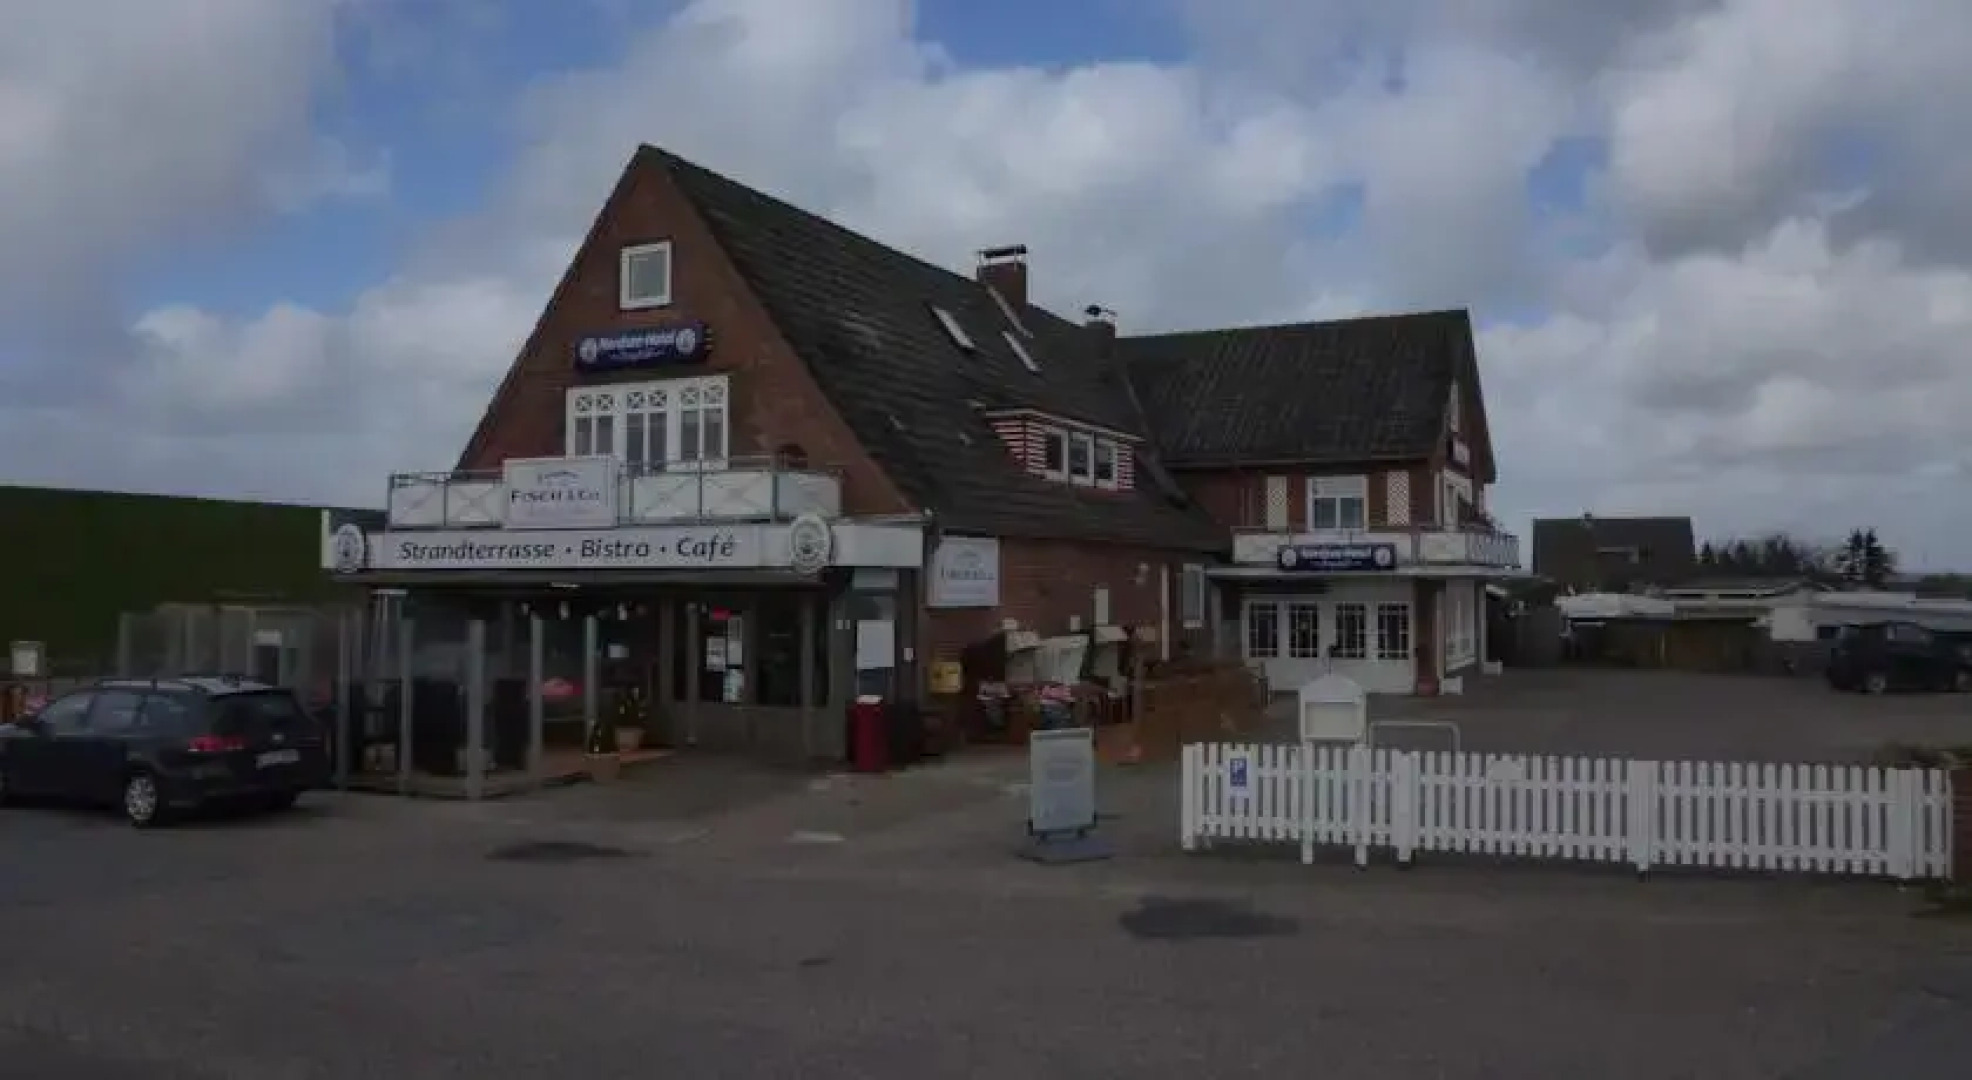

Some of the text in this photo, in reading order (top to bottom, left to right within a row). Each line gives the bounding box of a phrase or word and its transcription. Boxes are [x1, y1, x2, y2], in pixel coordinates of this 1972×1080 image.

[400, 534, 735, 561] Strandterrasse Bistro Café
